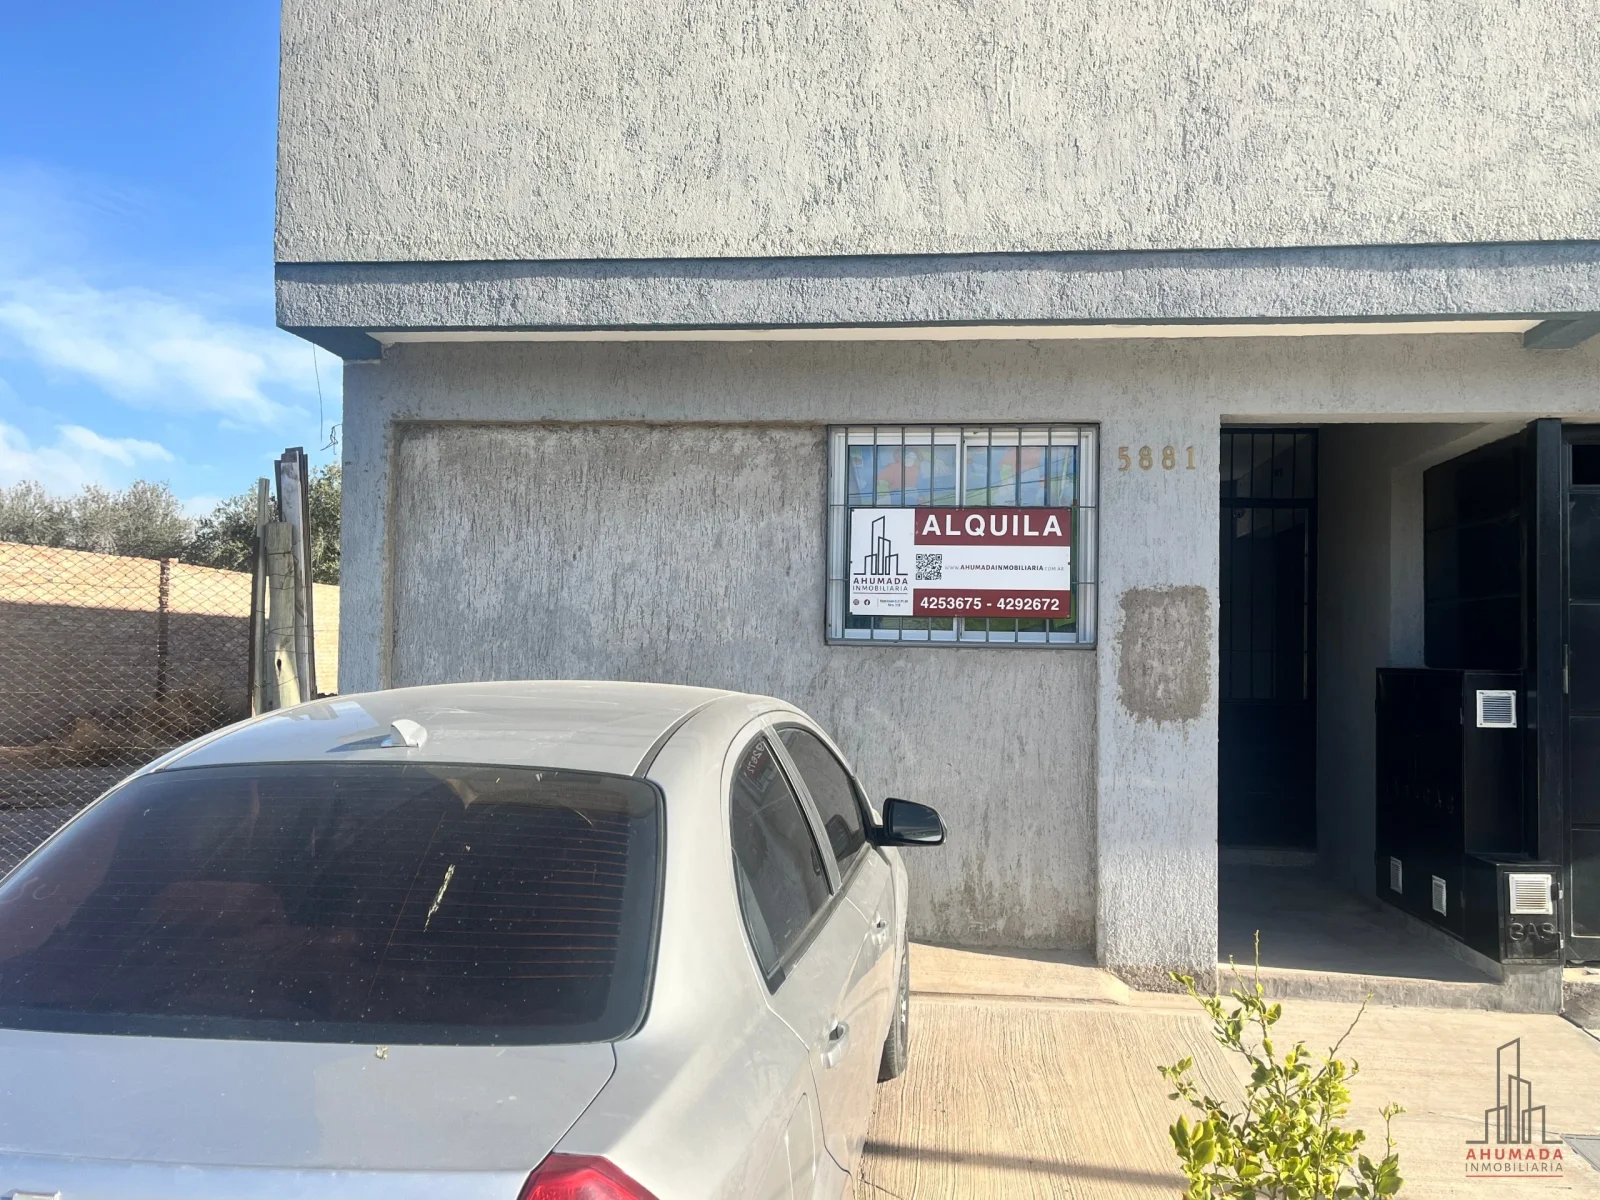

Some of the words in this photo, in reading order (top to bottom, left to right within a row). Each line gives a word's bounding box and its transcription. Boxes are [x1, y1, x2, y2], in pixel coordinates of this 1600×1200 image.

[1117, 445, 1196, 472] 5881
[921, 513, 1063, 537] ALQUILA
[853, 577, 908, 585] AHUMADA
[920, 596, 982, 610] 4253675
[996, 598, 1060, 611] 4292672
[1509, 922, 1556, 941] GAS
